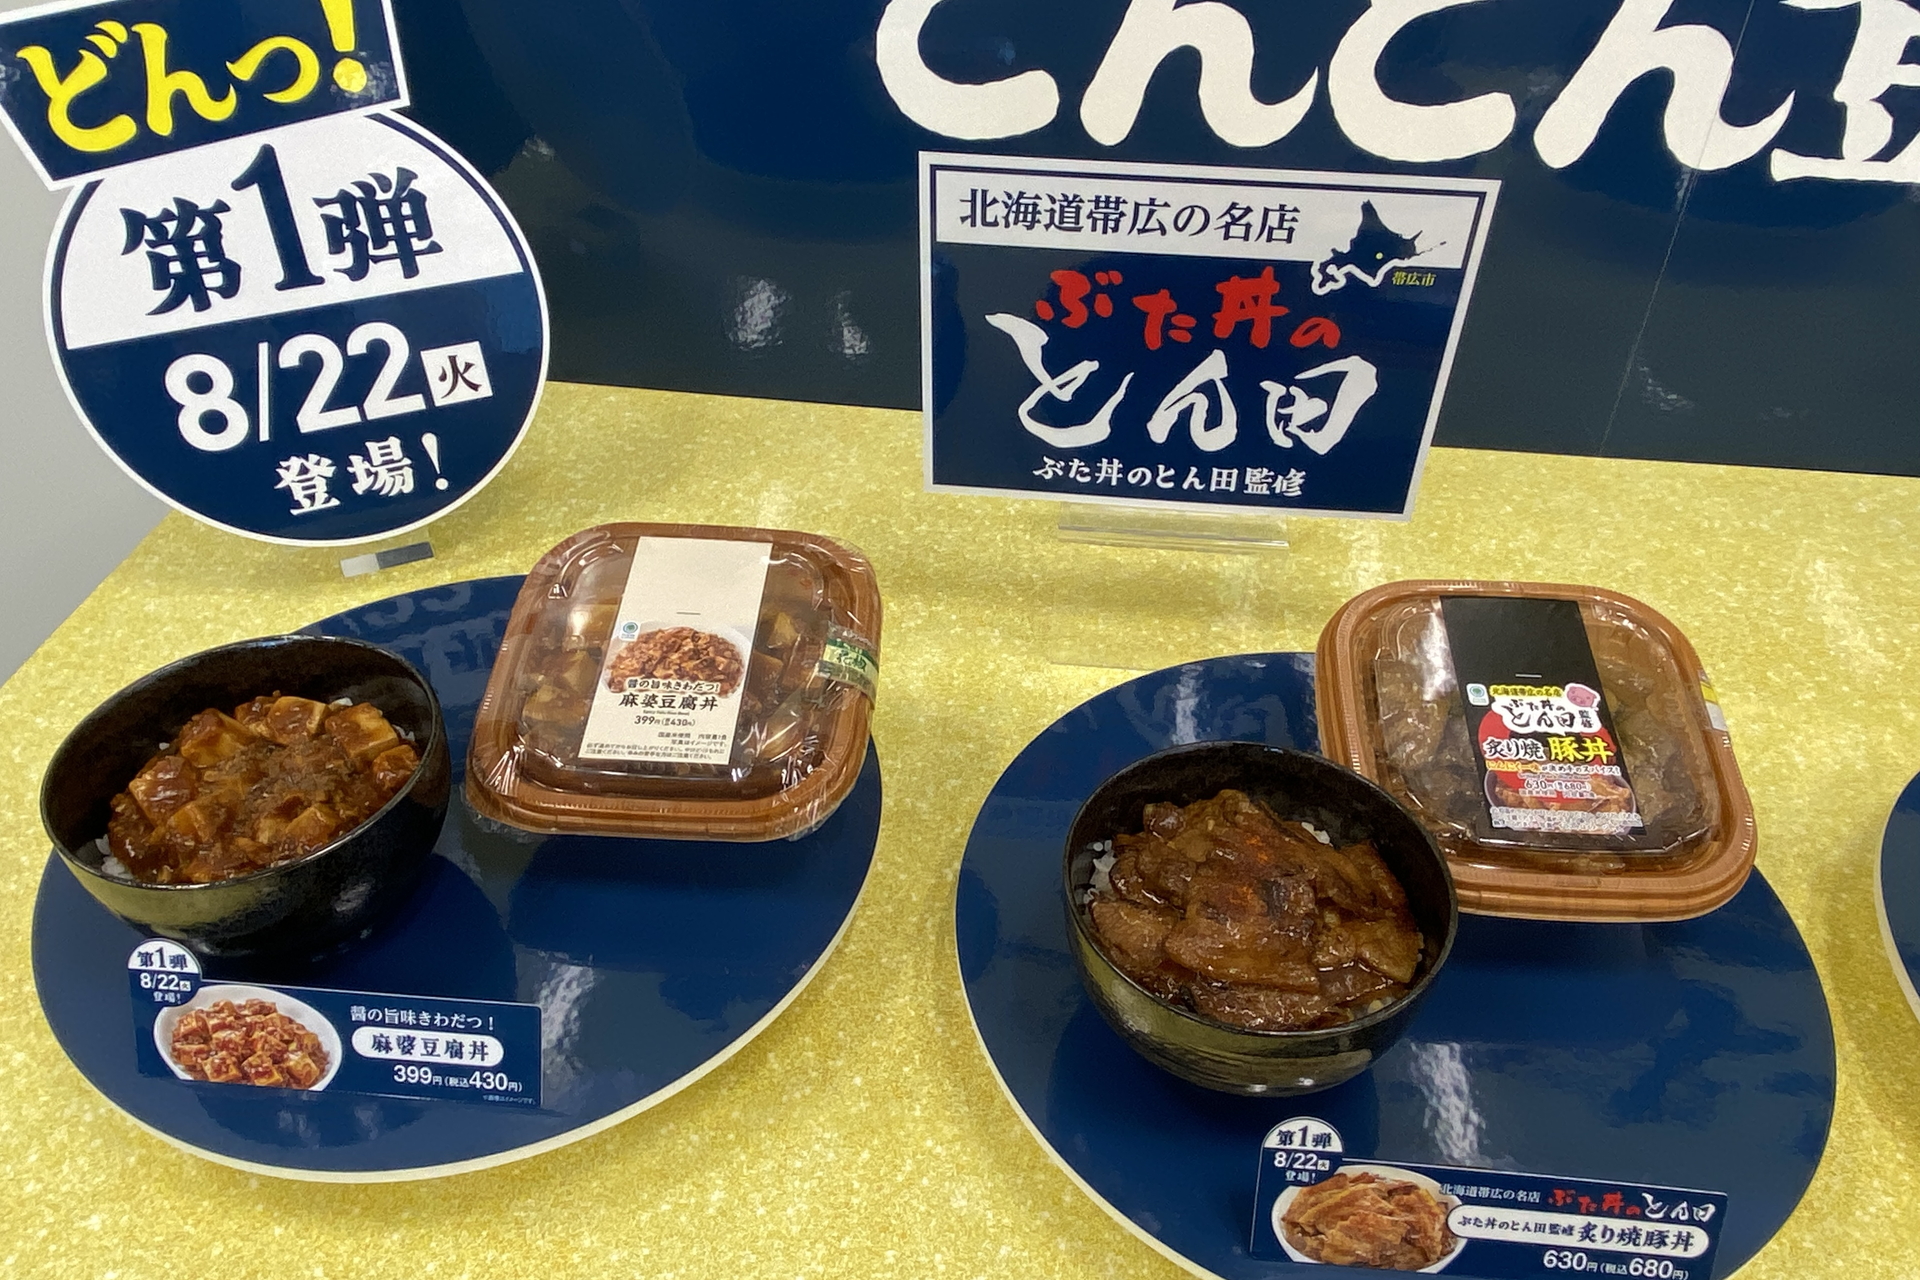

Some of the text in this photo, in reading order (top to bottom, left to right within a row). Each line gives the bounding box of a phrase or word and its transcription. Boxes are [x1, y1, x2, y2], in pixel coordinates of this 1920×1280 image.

[16, 0, 367, 153] どんっ!
[120, 143, 443, 316] 第1弾
[959, 187, 1301, 244] 北海道帯広の名店
[1392, 271, 1437, 287] 帯広市
[1035, 265, 1342, 350] ぶた丼の
[985, 312, 1378, 455] とん田
[273, 432, 450, 516] 登場!
[1033, 455, 1307, 497] ぶた丼のとん田監修
[618, 692, 719, 712] 麻婆豆腐丼
[137, 946, 189, 971] 第1弾
[350, 1005, 495, 1031] 醤の旨味きわだつ!
[371, 1033, 489, 1062] 麻婆豆腐丼
[1276, 1125, 1332, 1149] 第1弾
[1439, 1183, 1541, 1203] 北海道帯広の名店
